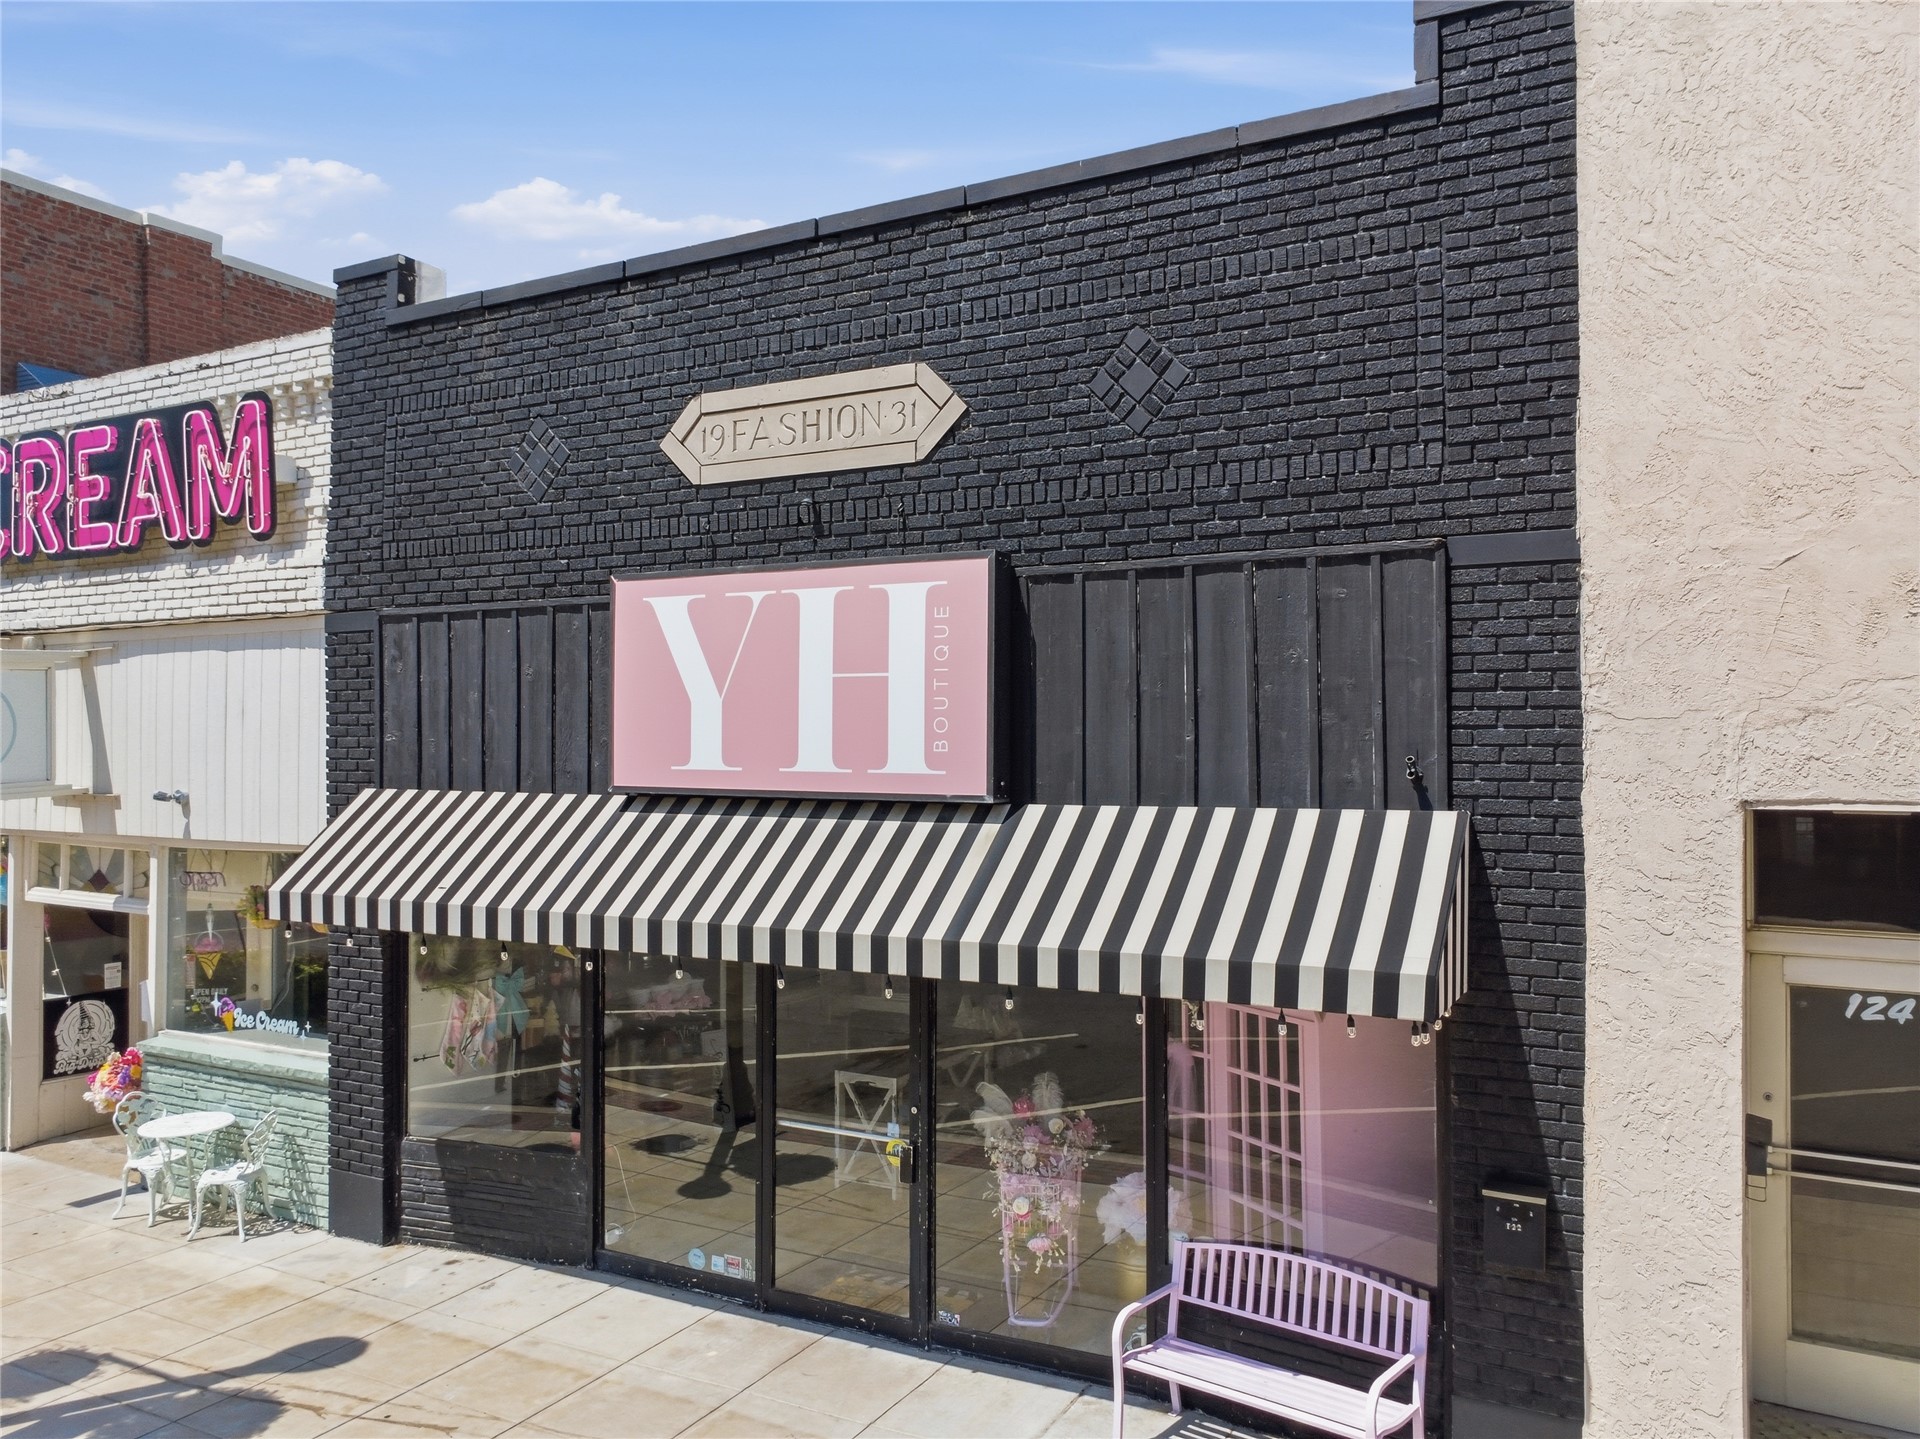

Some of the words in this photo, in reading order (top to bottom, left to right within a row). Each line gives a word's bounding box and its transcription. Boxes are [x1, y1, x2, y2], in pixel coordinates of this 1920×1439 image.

[731, 400, 881, 453] FASHION
[643, 580, 948, 775] YH
[933, 605, 950, 752] BOUTIQUE
[233, 1007, 255, 1029] Ice
[255, 1010, 300, 1035] Cream
[1844, 993, 1917, 1025] 124
[77, 1056, 107, 1070] Dipp
